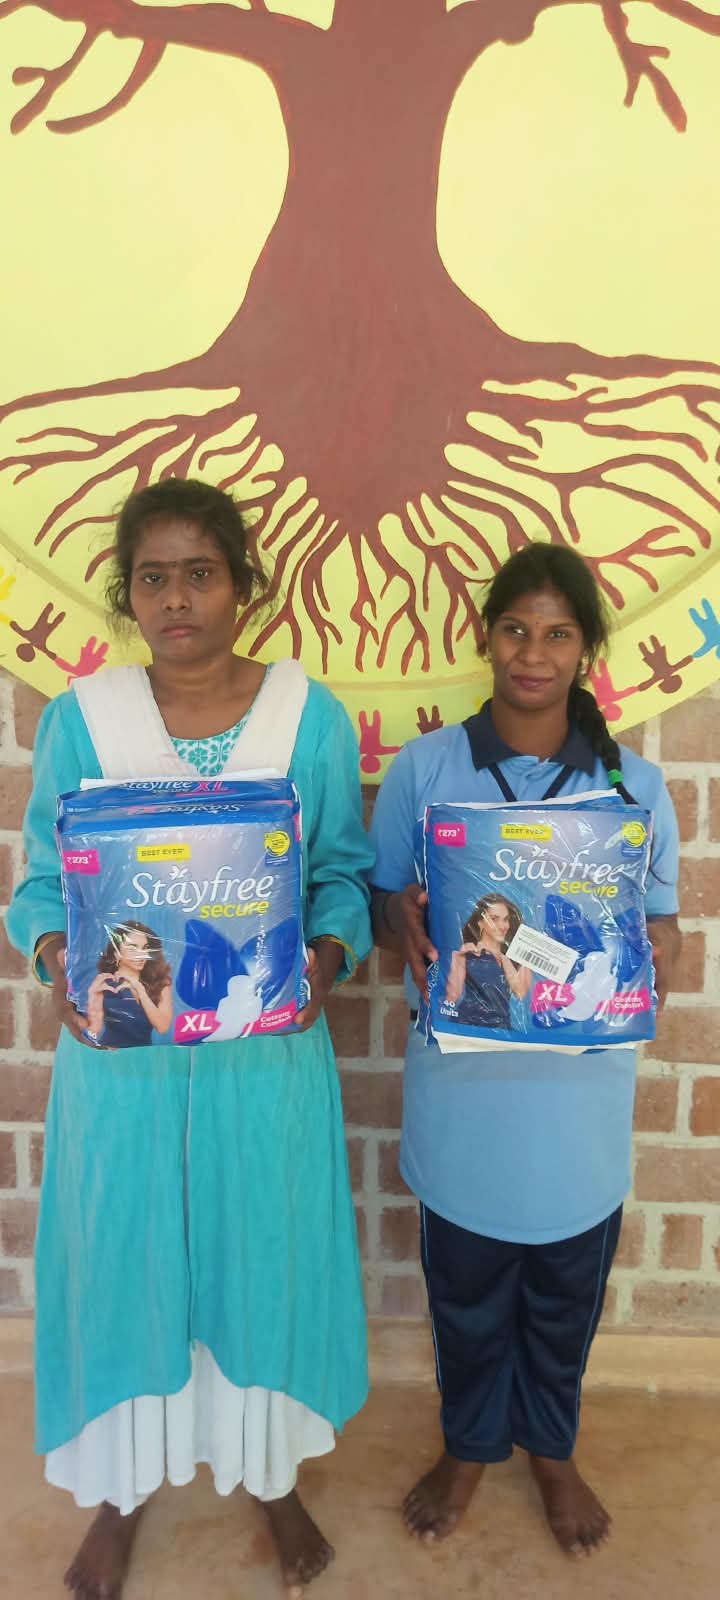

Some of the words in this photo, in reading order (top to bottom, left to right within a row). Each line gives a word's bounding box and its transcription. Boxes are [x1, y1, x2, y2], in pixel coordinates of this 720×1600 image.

[141, 849, 160, 857] BEST
[162, 848, 185, 856] EVER
[488, 848, 623, 888] Stayfree
[126, 866, 274, 912] Stayfree
[559, 880, 619, 898] secure
[199, 900, 270, 919] secure
[538, 983, 568, 1003] XL
[440, 1007, 459, 1017] Units
[443, 999, 456, 1008] 40
[180, 1013, 213, 1033] XL
